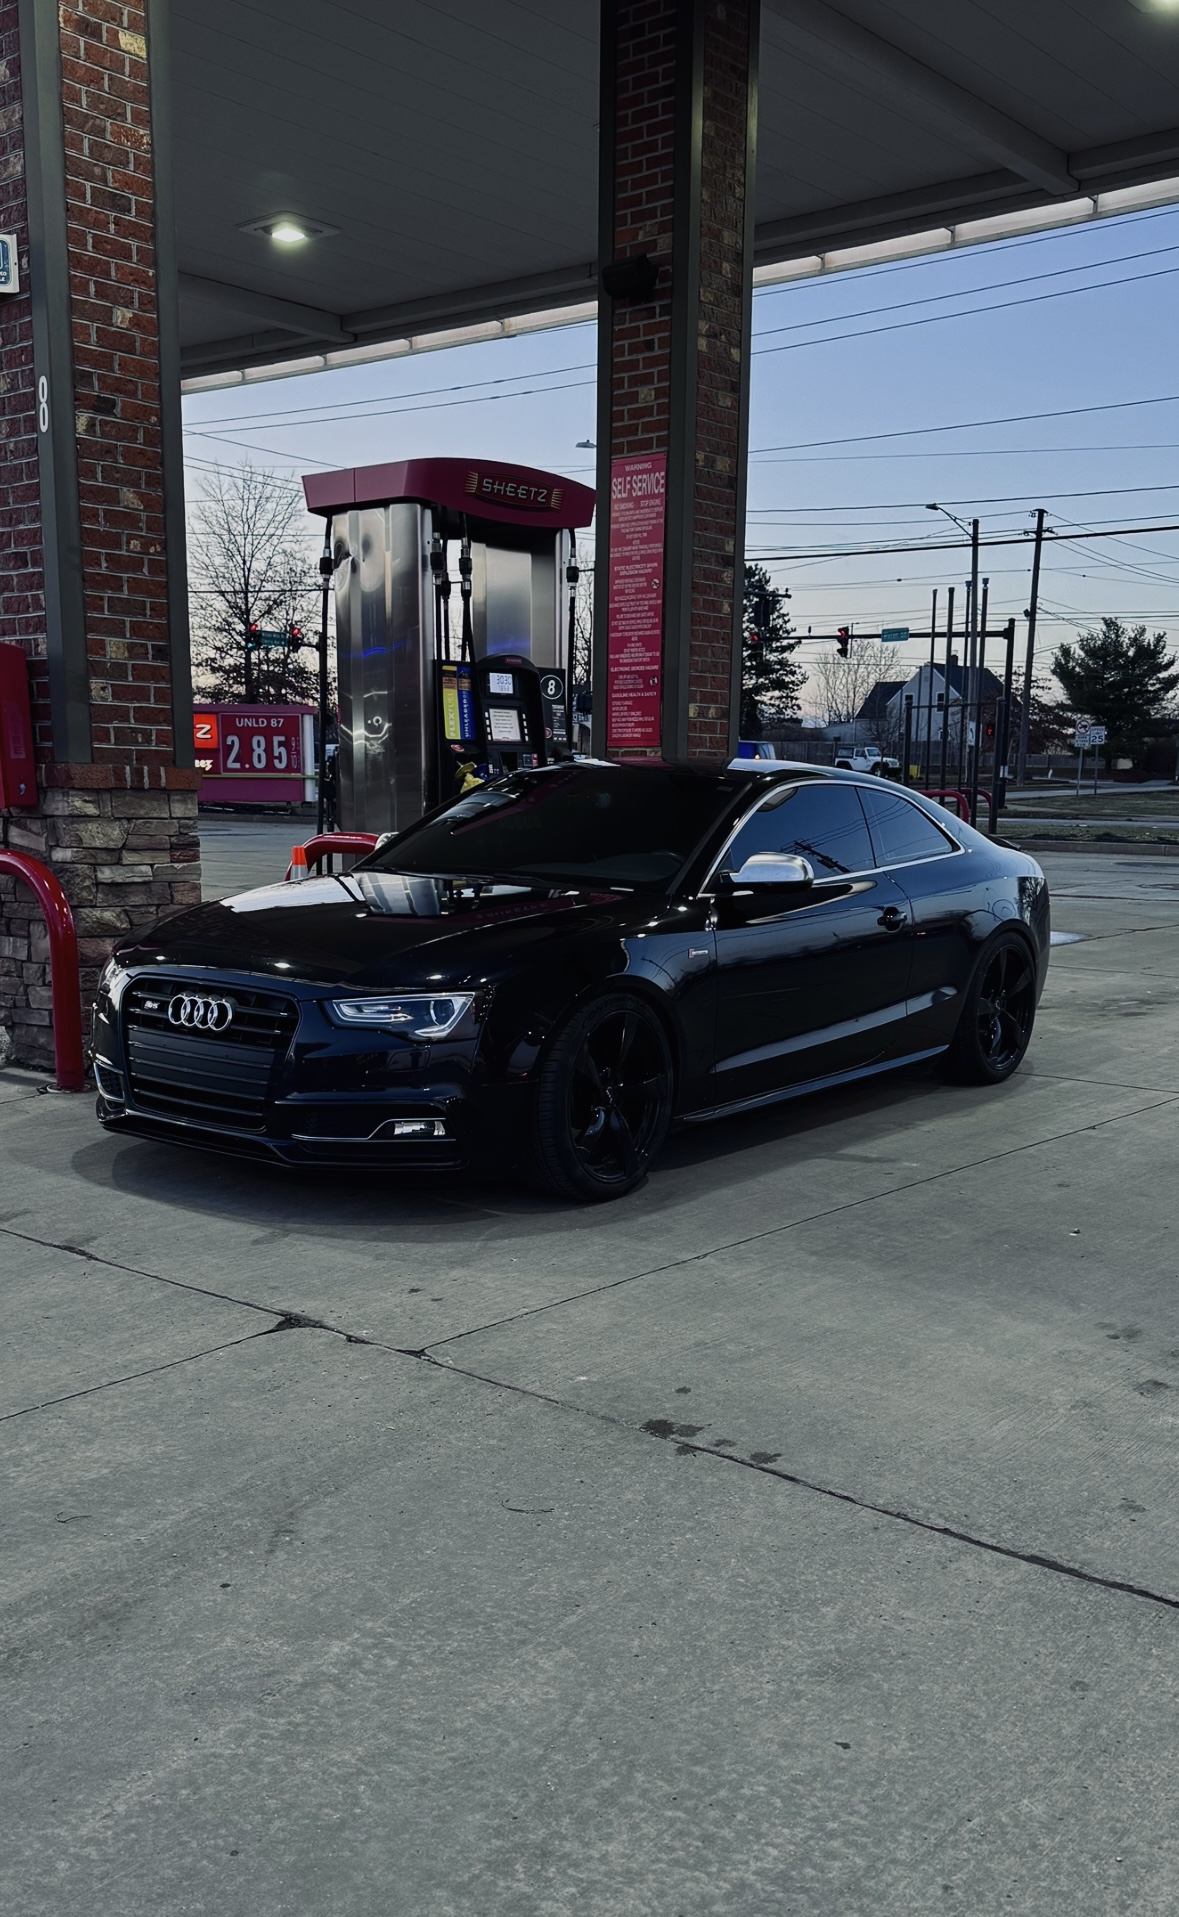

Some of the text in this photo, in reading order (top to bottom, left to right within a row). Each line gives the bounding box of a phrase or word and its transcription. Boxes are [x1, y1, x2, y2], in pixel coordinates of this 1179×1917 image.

[39, 375, 48, 432] 8
[625, 462, 652, 471] WARNING
[482, 478, 547, 502] SHEETZ
[611, 472, 665, 499] SELF SERVICE
[547, 680, 556, 695] 8
[236, 718, 284, 727] UNLD 87
[1091, 735, 1104, 743] 25
[226, 735, 288, 769] 2.85
